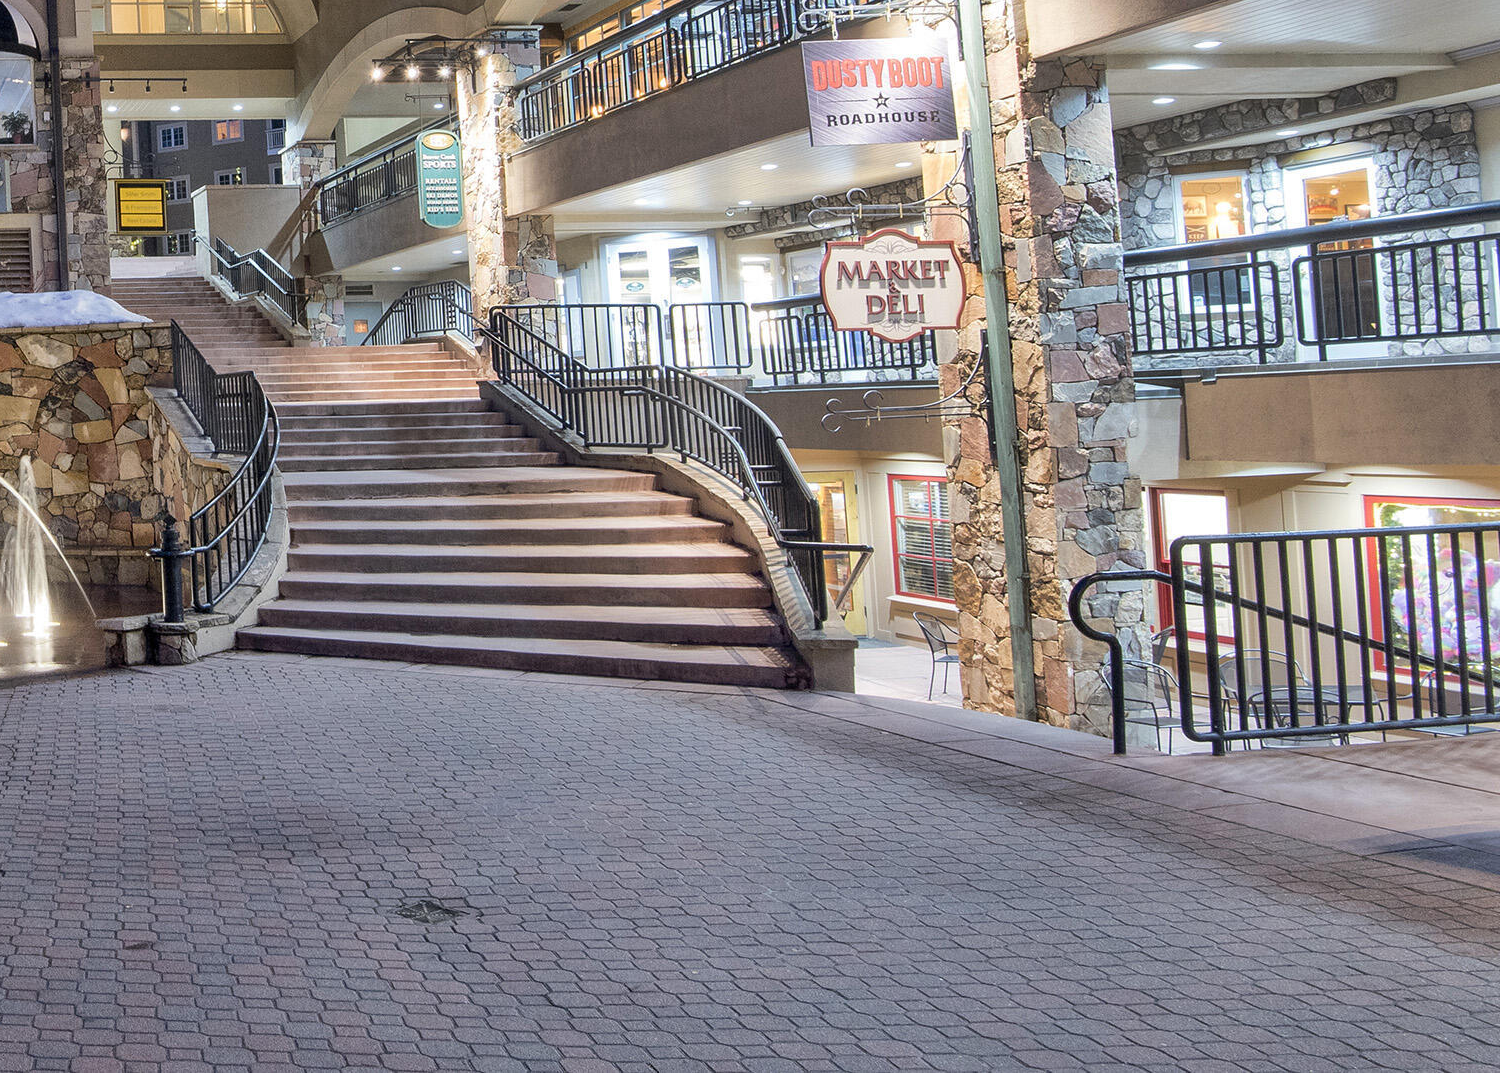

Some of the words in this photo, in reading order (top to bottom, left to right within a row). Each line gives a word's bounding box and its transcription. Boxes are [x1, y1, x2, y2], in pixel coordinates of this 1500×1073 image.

[811, 58, 884, 92] DUSTY
[888, 56, 944, 89] BOOT
[826, 110, 941, 127] ROADHOUSE
[836, 259, 950, 281] MARKET
[888, 280, 901, 294] &
[866, 294, 926, 315] DELI
